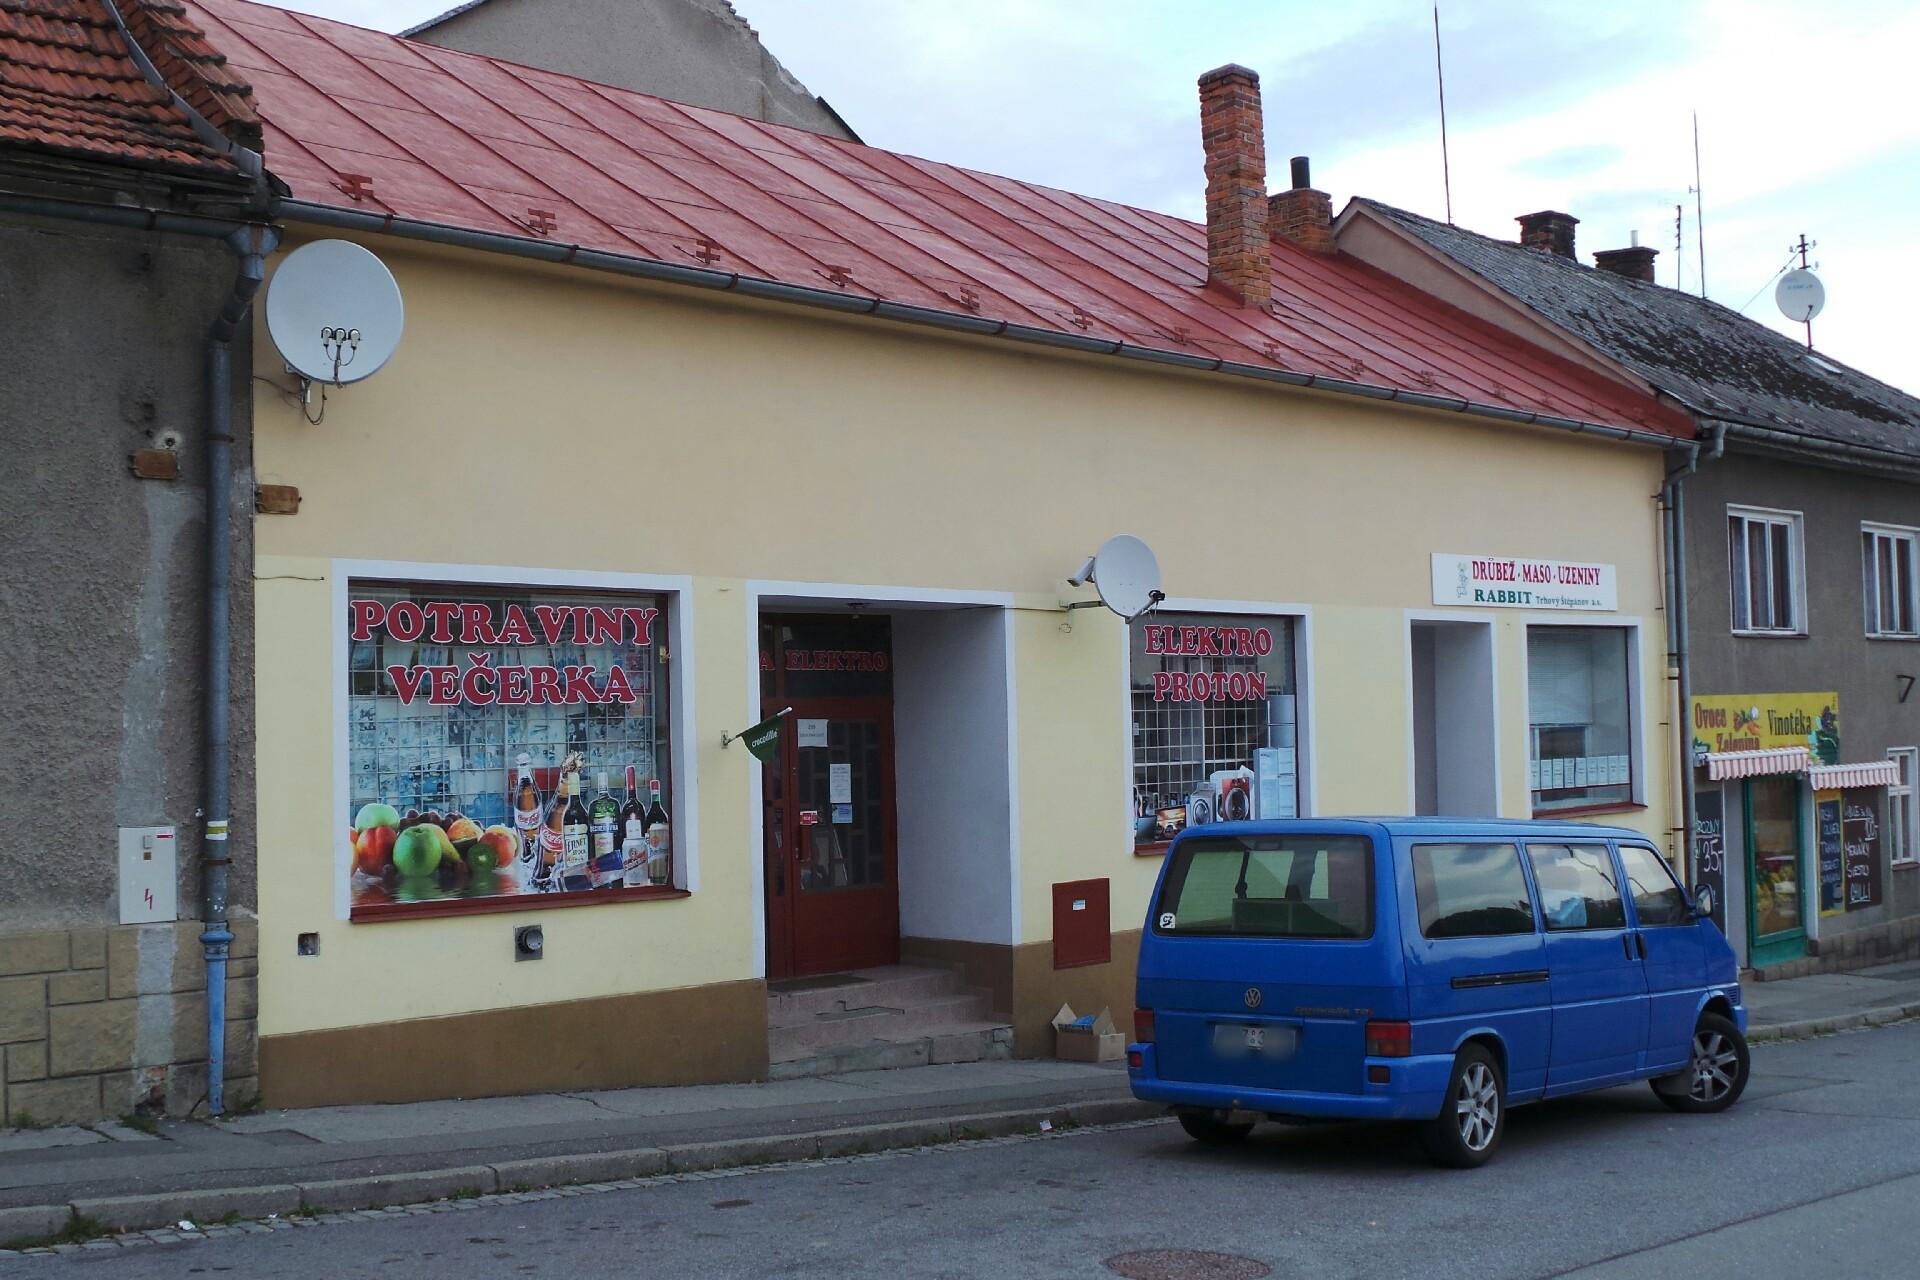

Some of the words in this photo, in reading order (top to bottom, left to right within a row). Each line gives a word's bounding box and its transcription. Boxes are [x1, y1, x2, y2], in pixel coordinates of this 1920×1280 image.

[1472, 557, 1516, 582] DRŮBEŽ
[1522, 564, 1551, 584] MASO
[1558, 566, 1601, 586] UZENINY
[1474, 589, 1532, 604] RABBIT
[350, 599, 659, 646] POTRAVINY
[1144, 625, 1273, 656] ELEKTRO
[785, 650, 889, 672] ELEKTRO
[386, 652, 637, 706] VEČERKA
[1153, 672, 1268, 701] PROTON
[1694, 702, 1727, 729] Ovoce
[1767, 708, 1812, 737] Vinotéka
